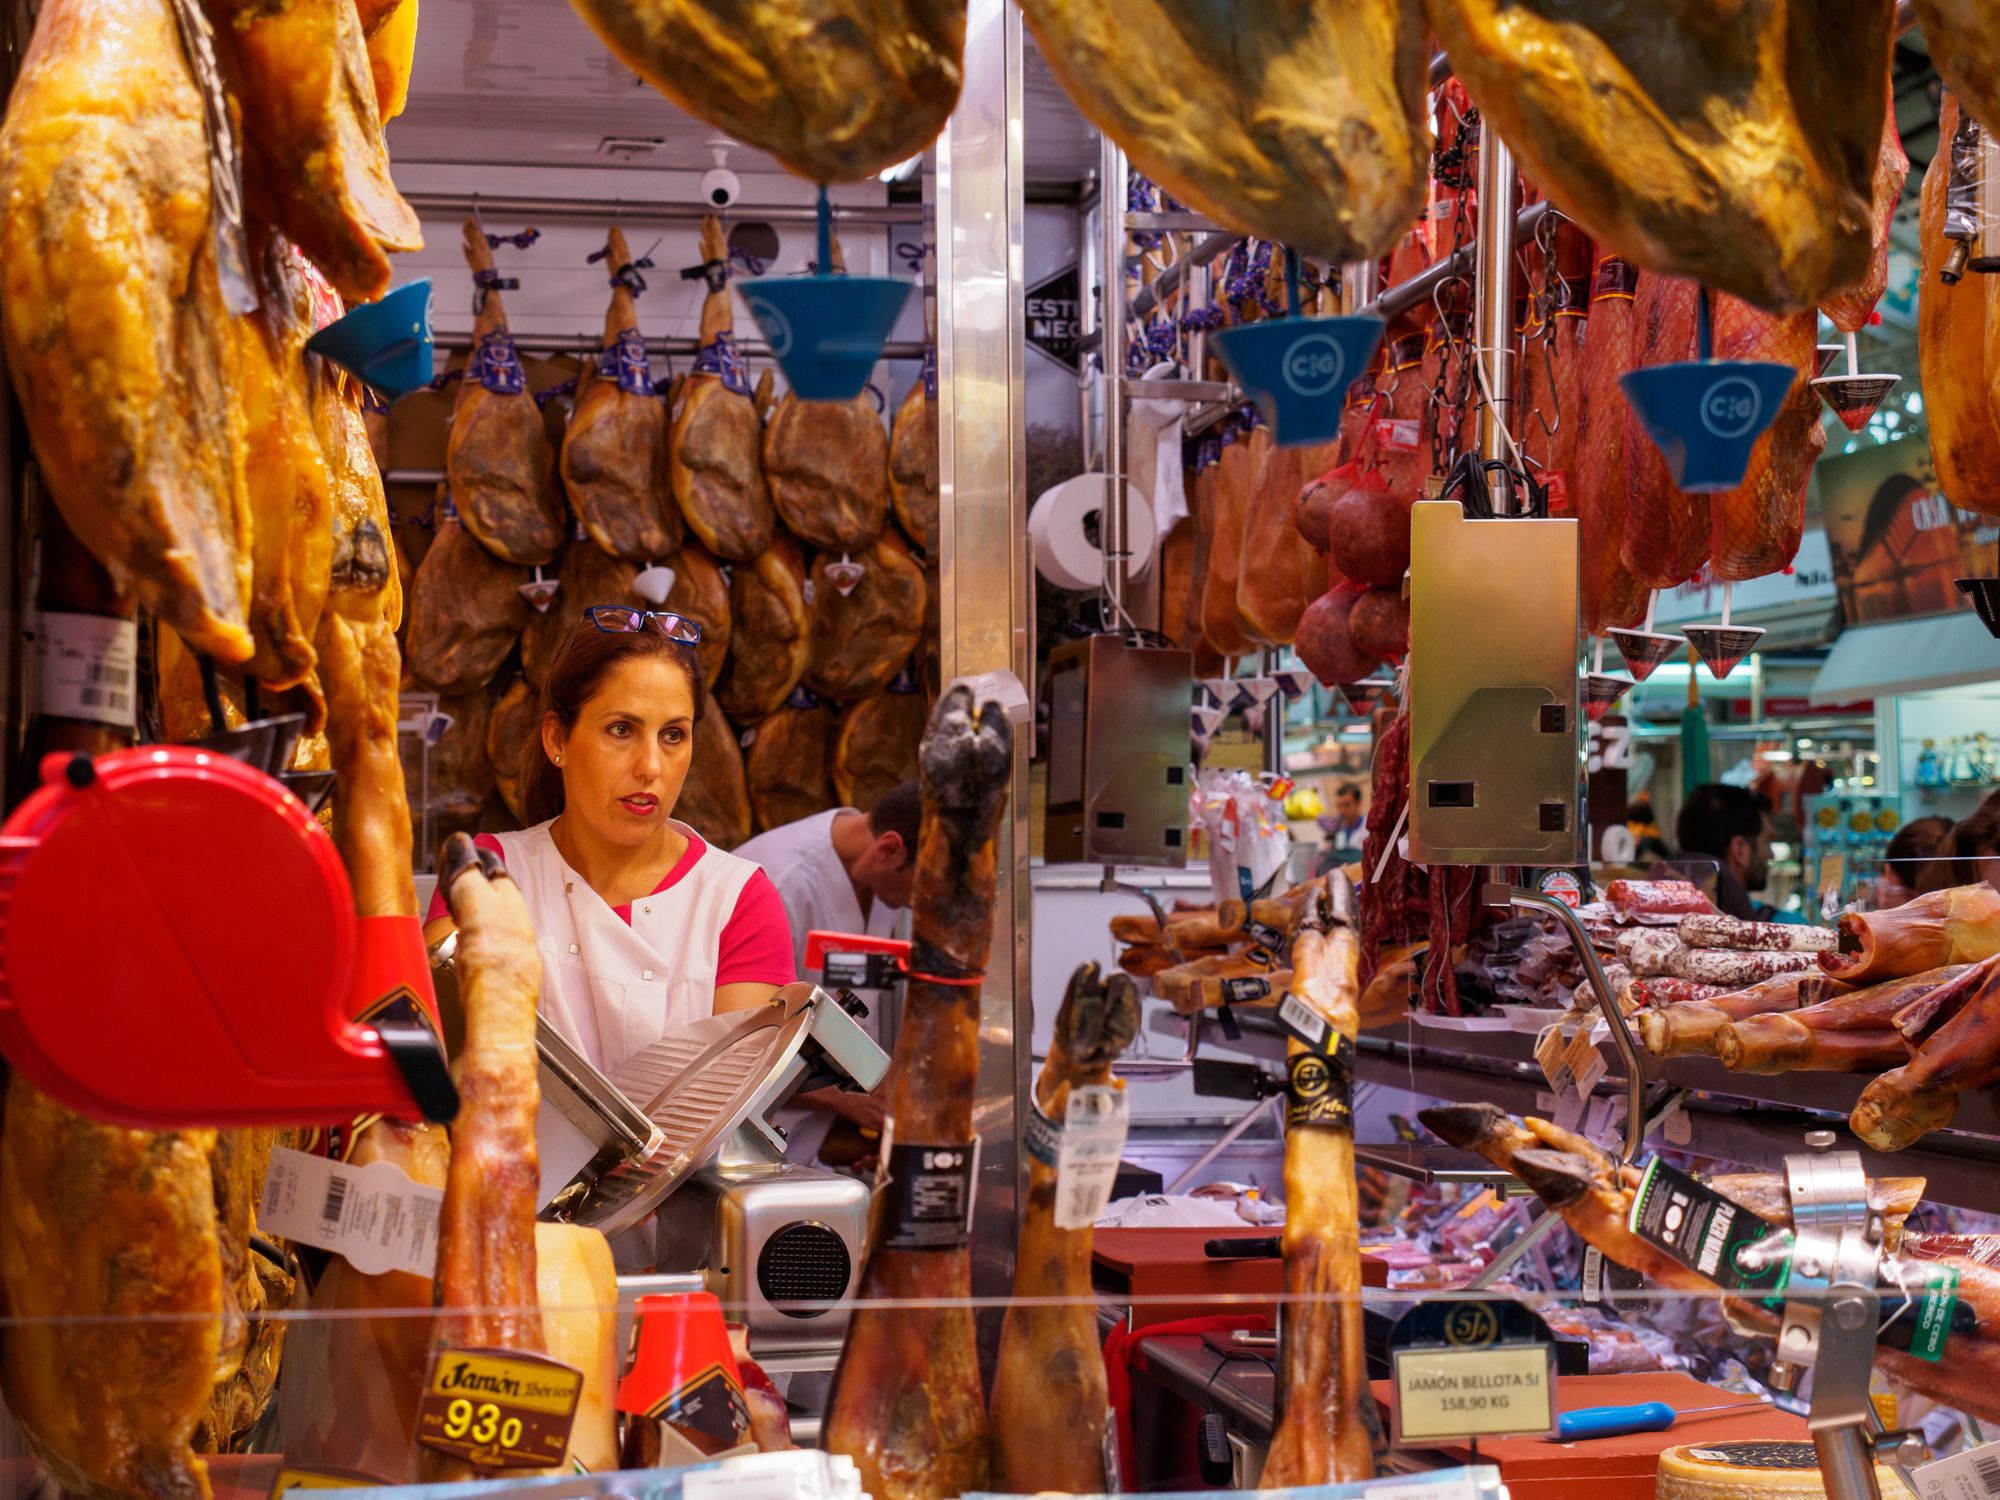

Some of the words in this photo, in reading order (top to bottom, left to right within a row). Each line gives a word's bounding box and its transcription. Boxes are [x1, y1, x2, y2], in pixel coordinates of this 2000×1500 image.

[440, 1361, 521, 1397] Jamón
[1408, 1375, 1459, 1393] JAMÓN
[1462, 1374, 1522, 1390] BELLOTA
[1441, 1395, 1487, 1411] 158,90
[1490, 1395, 1510, 1410] KG
